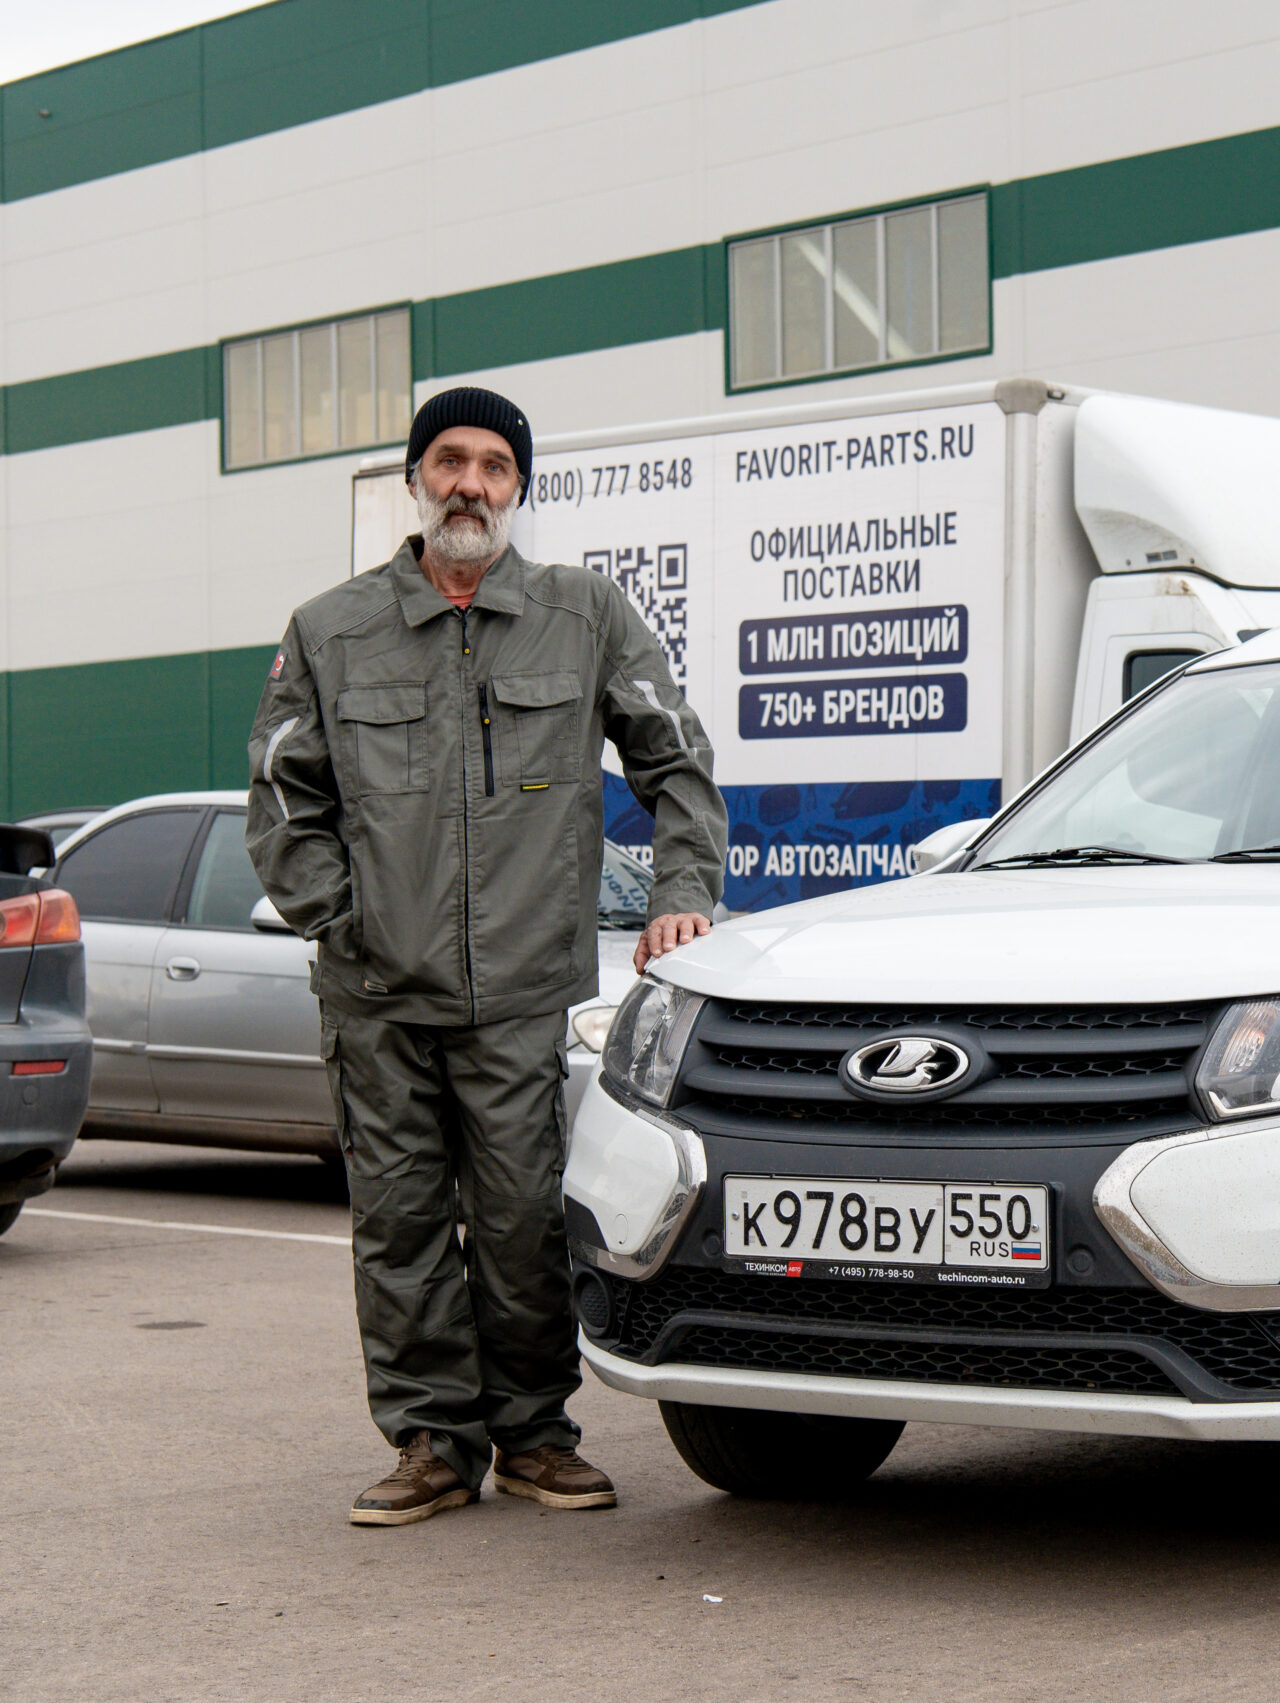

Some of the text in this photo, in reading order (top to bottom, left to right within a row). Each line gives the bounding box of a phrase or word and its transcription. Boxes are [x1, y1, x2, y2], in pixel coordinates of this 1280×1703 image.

[736, 424, 974, 482] FAVORIT-PARTS.RU
[530, 457, 692, 512] (800) 777 8548
[751, 511, 957, 564] ОФИЦИАЛЬНЫЕ
[783, 559, 920, 602] ПОСТАВКИ
[747, 608, 960, 663] 1 МЛН ПОЗИЦИЙ
[758, 685, 944, 729] 750+ БРЕНДОВ
[950, 1193, 1032, 1240] 550
[745, 1262, 787, 1273] ТЕХИНКОМ
[970, 1241, 1010, 1258] RUS
[828, 1266, 914, 1279] +7 (495) 778-98-50
[938, 1272, 1025, 1285] techincom-auto.ru
